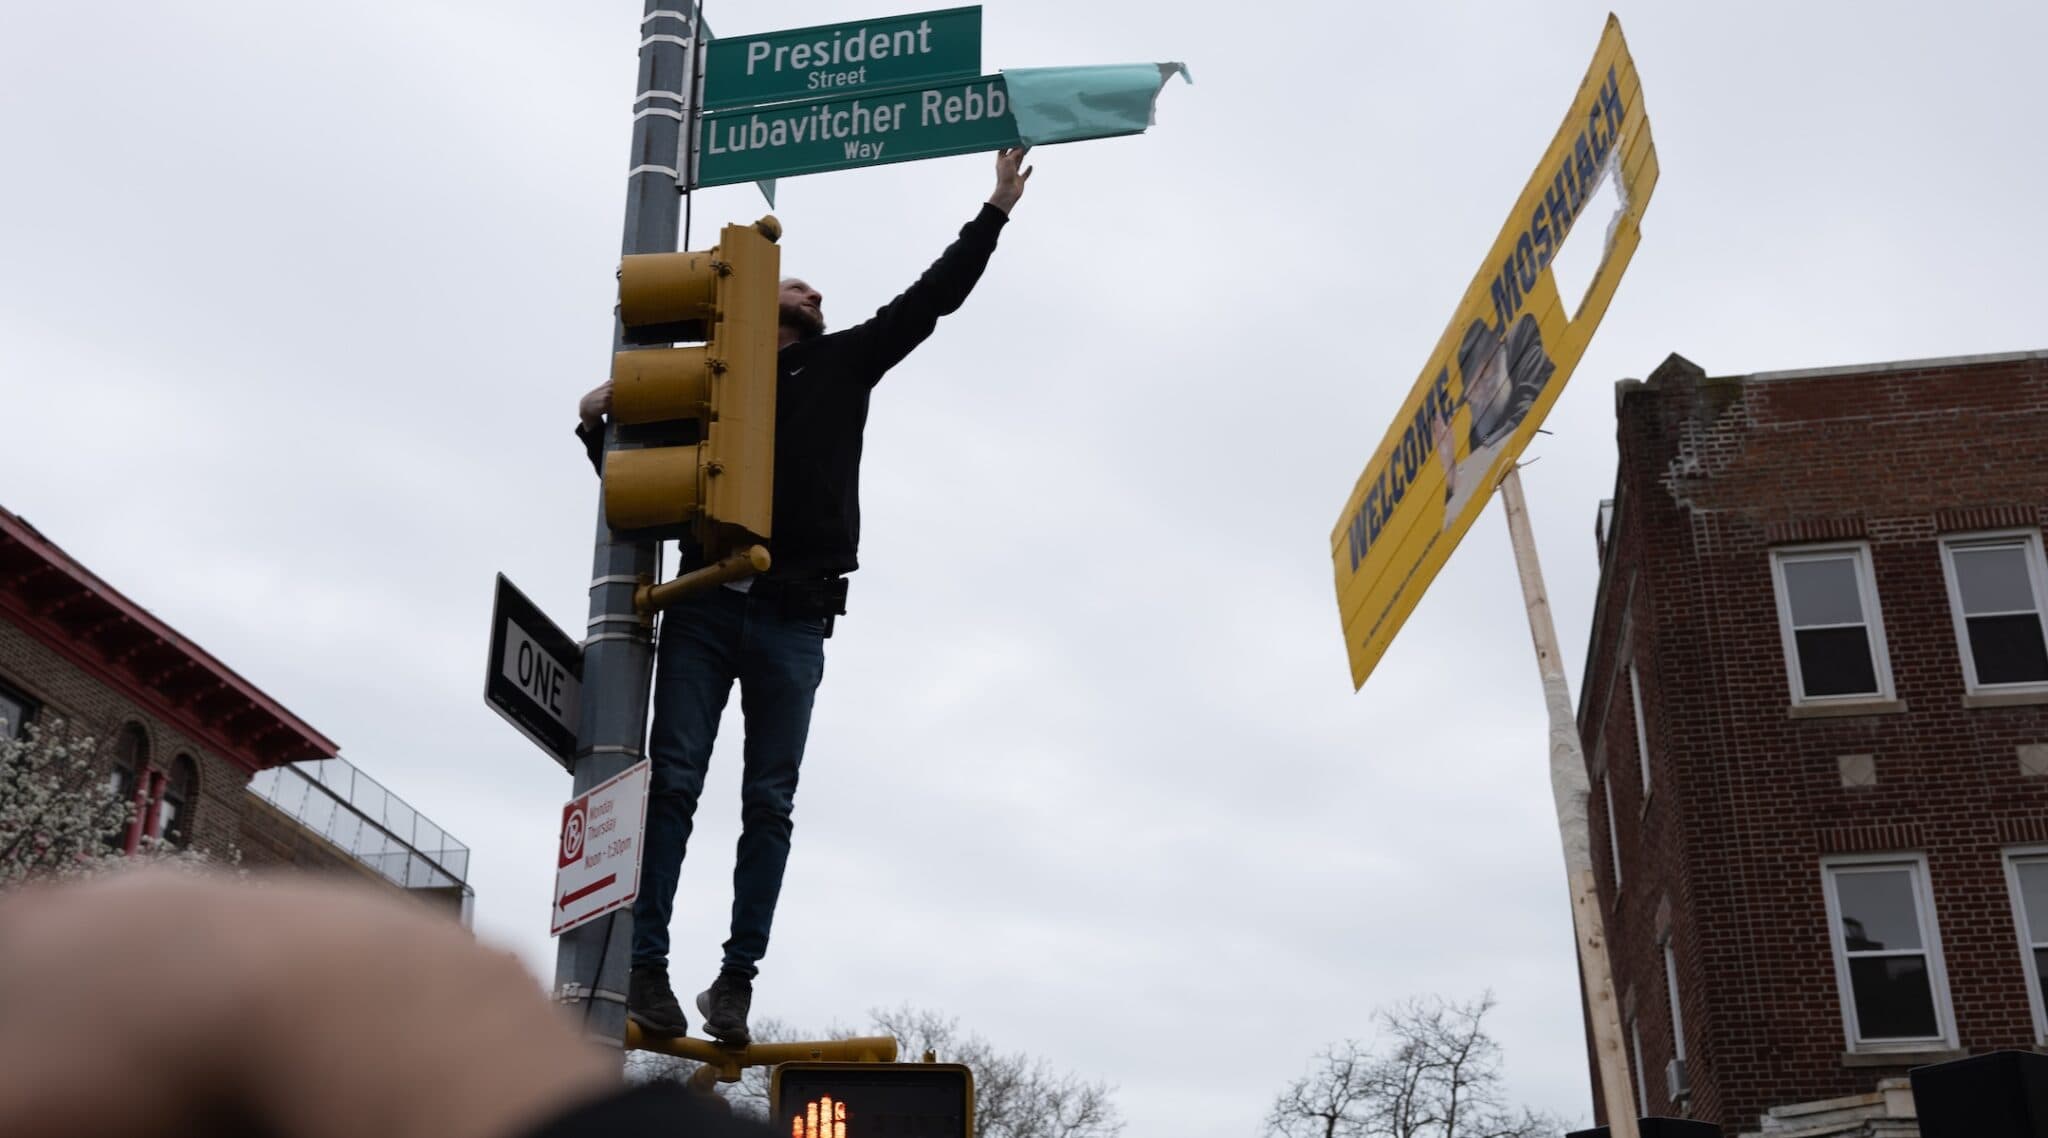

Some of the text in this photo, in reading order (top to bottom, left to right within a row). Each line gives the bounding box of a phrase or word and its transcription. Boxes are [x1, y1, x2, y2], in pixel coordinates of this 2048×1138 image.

[746, 20, 932, 76] President
[807, 67, 866, 91] Street
[708, 82, 1013, 154] Lubavitcher Rebb
[843, 140, 884, 161] Way
[518, 640, 564, 717] ONE
